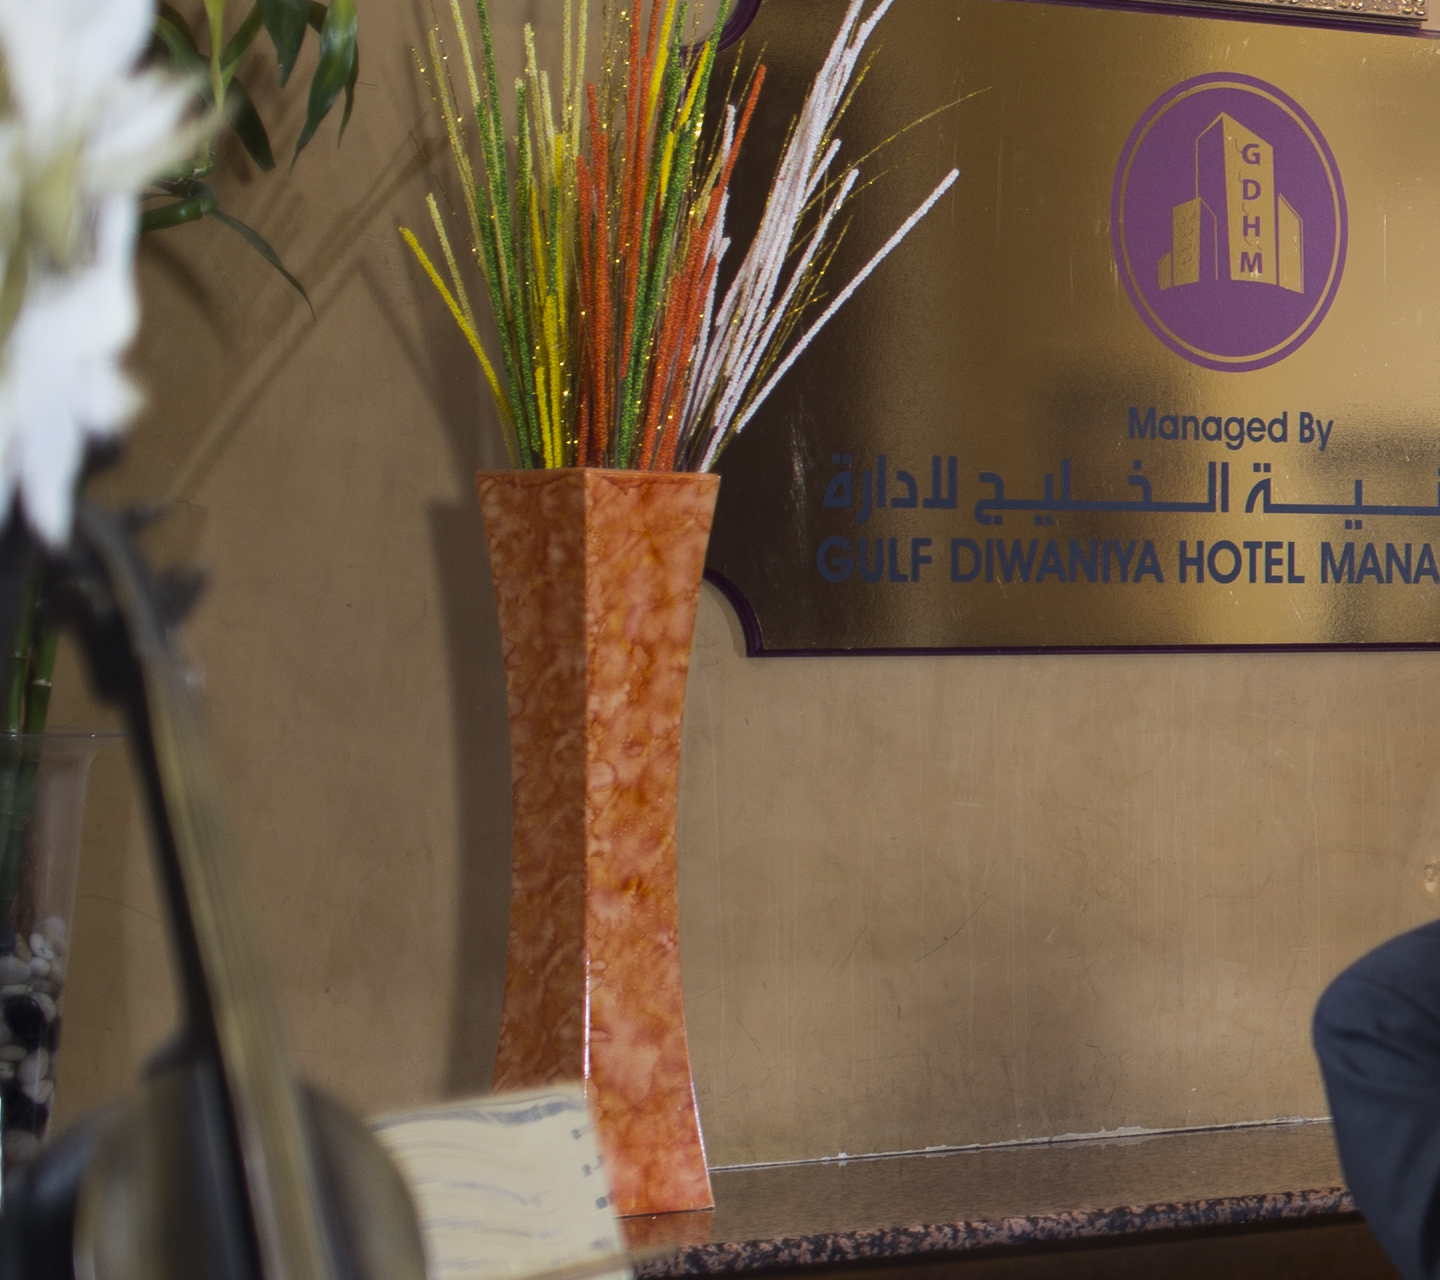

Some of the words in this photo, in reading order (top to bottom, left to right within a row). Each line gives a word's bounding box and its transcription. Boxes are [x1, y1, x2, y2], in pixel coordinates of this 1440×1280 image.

[1128, 406, 1288, 450] Managed
[1299, 412, 1334, 452] By
[974, 458, 1230, 526] الخليج
[816, 536, 933, 584] GULF
[951, 537, 1164, 584] DIWANIYA
[1179, 539, 1305, 584] HOTEL
